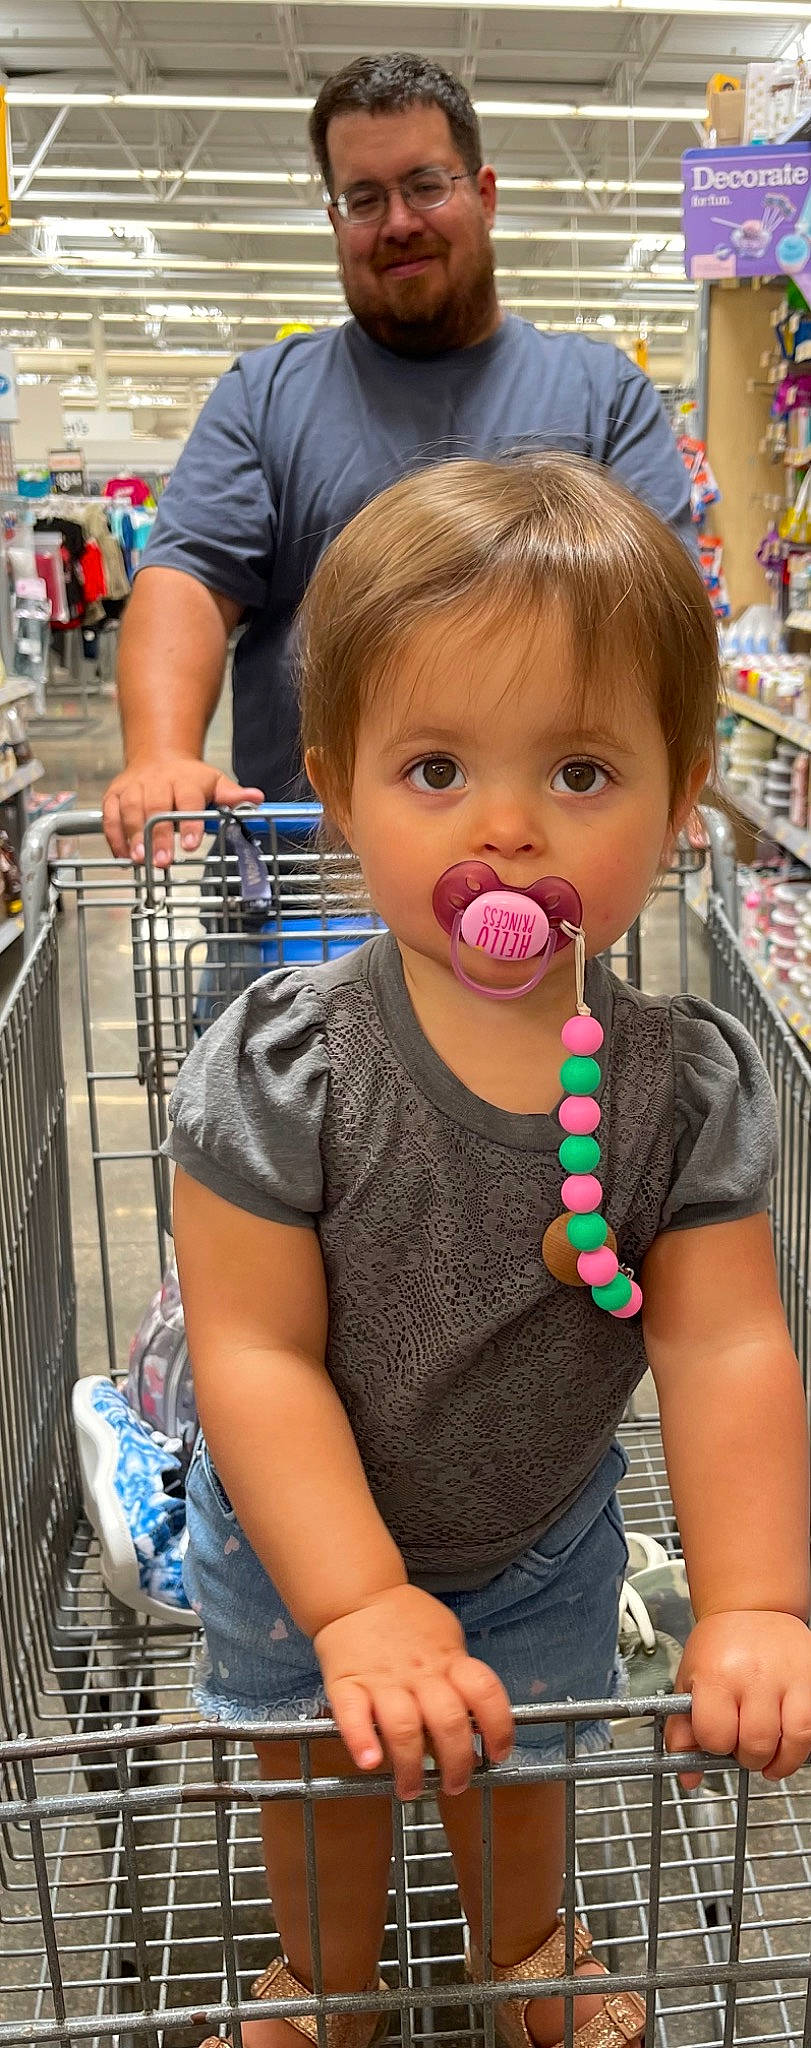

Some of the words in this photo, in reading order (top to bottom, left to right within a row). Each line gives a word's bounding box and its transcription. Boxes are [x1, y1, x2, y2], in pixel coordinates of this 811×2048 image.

[691, 162, 808, 191] Decorate
[482, 905, 537, 933] PRINCESS
[475, 925, 532, 958] HELLO
